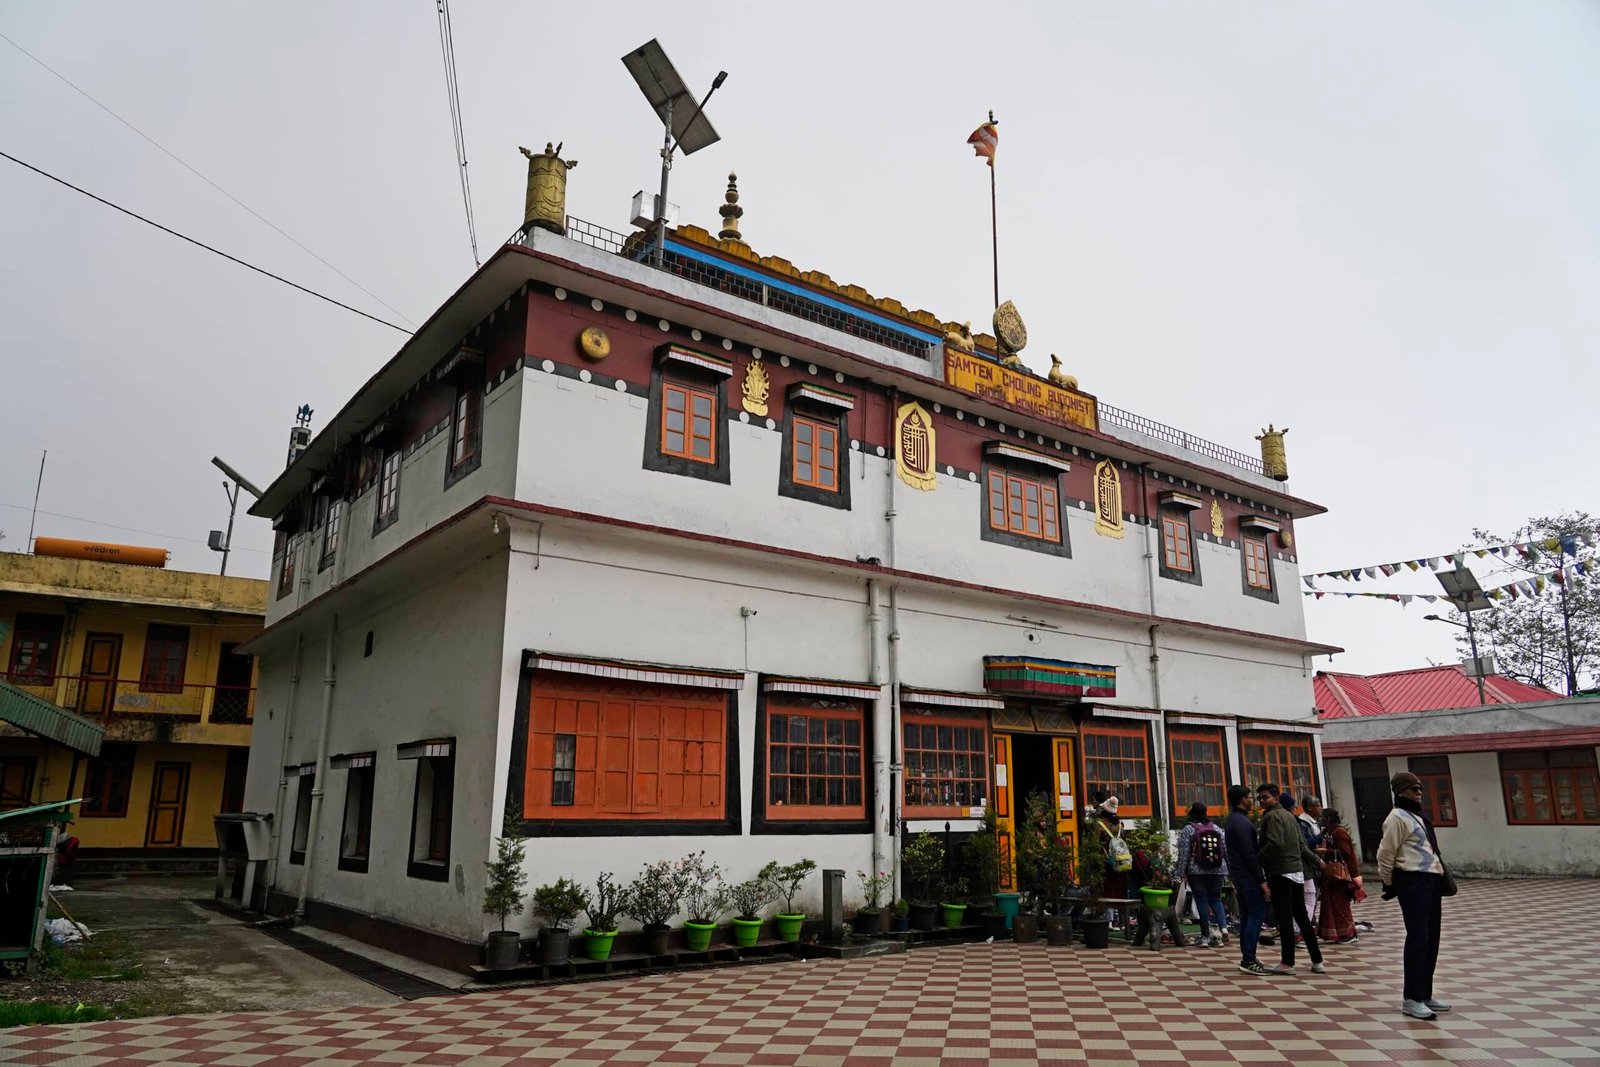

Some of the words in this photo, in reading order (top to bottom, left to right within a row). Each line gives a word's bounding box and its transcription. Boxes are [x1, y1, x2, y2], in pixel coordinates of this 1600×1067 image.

[946, 352, 993, 381] SAMTEN
[1003, 372, 1041, 398] CHOLING
[1047, 390, 1089, 414] BUDDHIST
